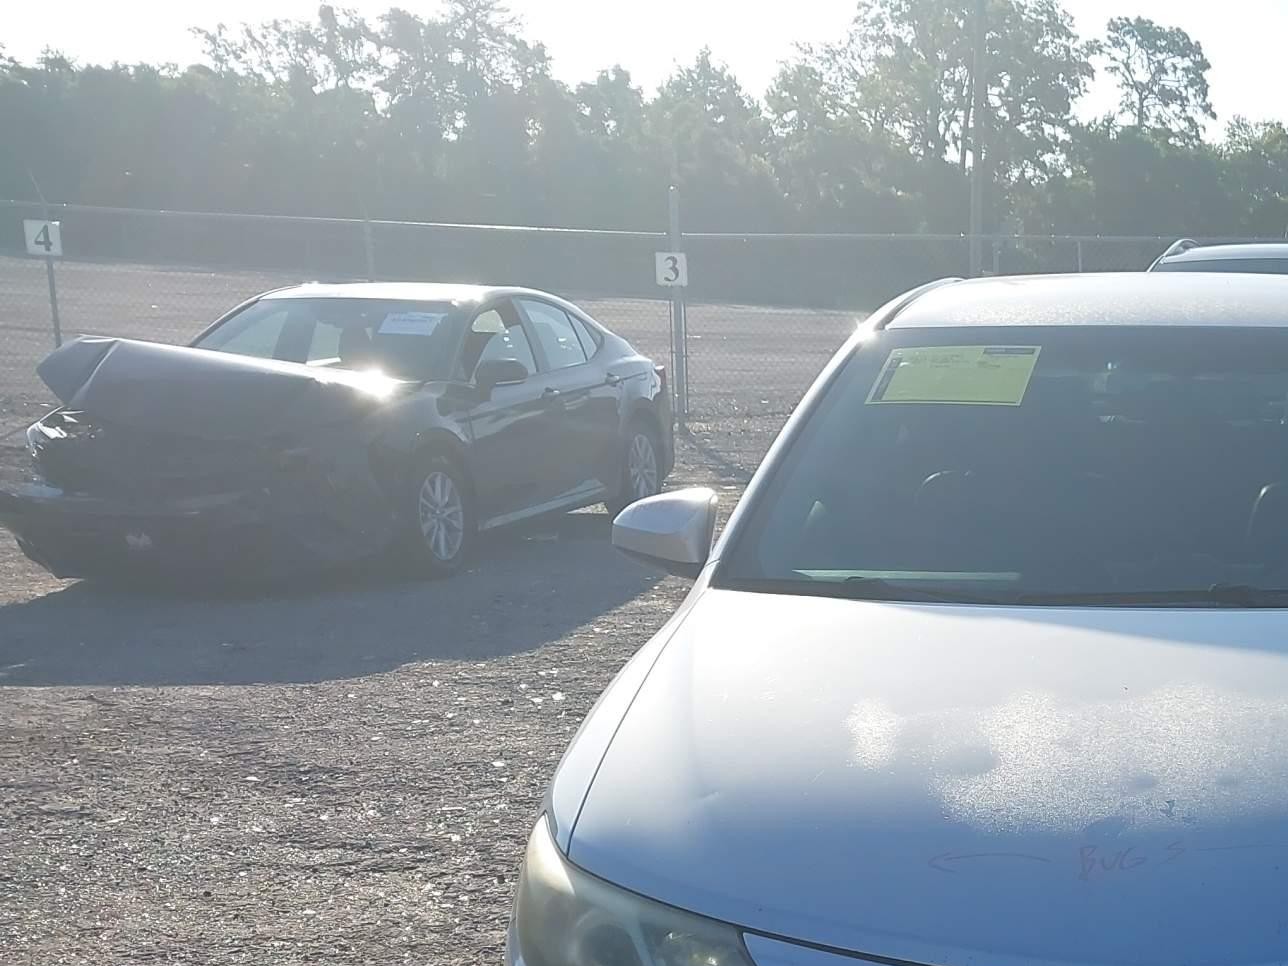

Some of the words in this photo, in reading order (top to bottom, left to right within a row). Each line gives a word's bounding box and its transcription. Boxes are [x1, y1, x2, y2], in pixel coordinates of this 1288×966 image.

[34, 224, 52, 252] 4
[663, 255, 680, 282] 3
[1080, 841, 1187, 878] BUGS
